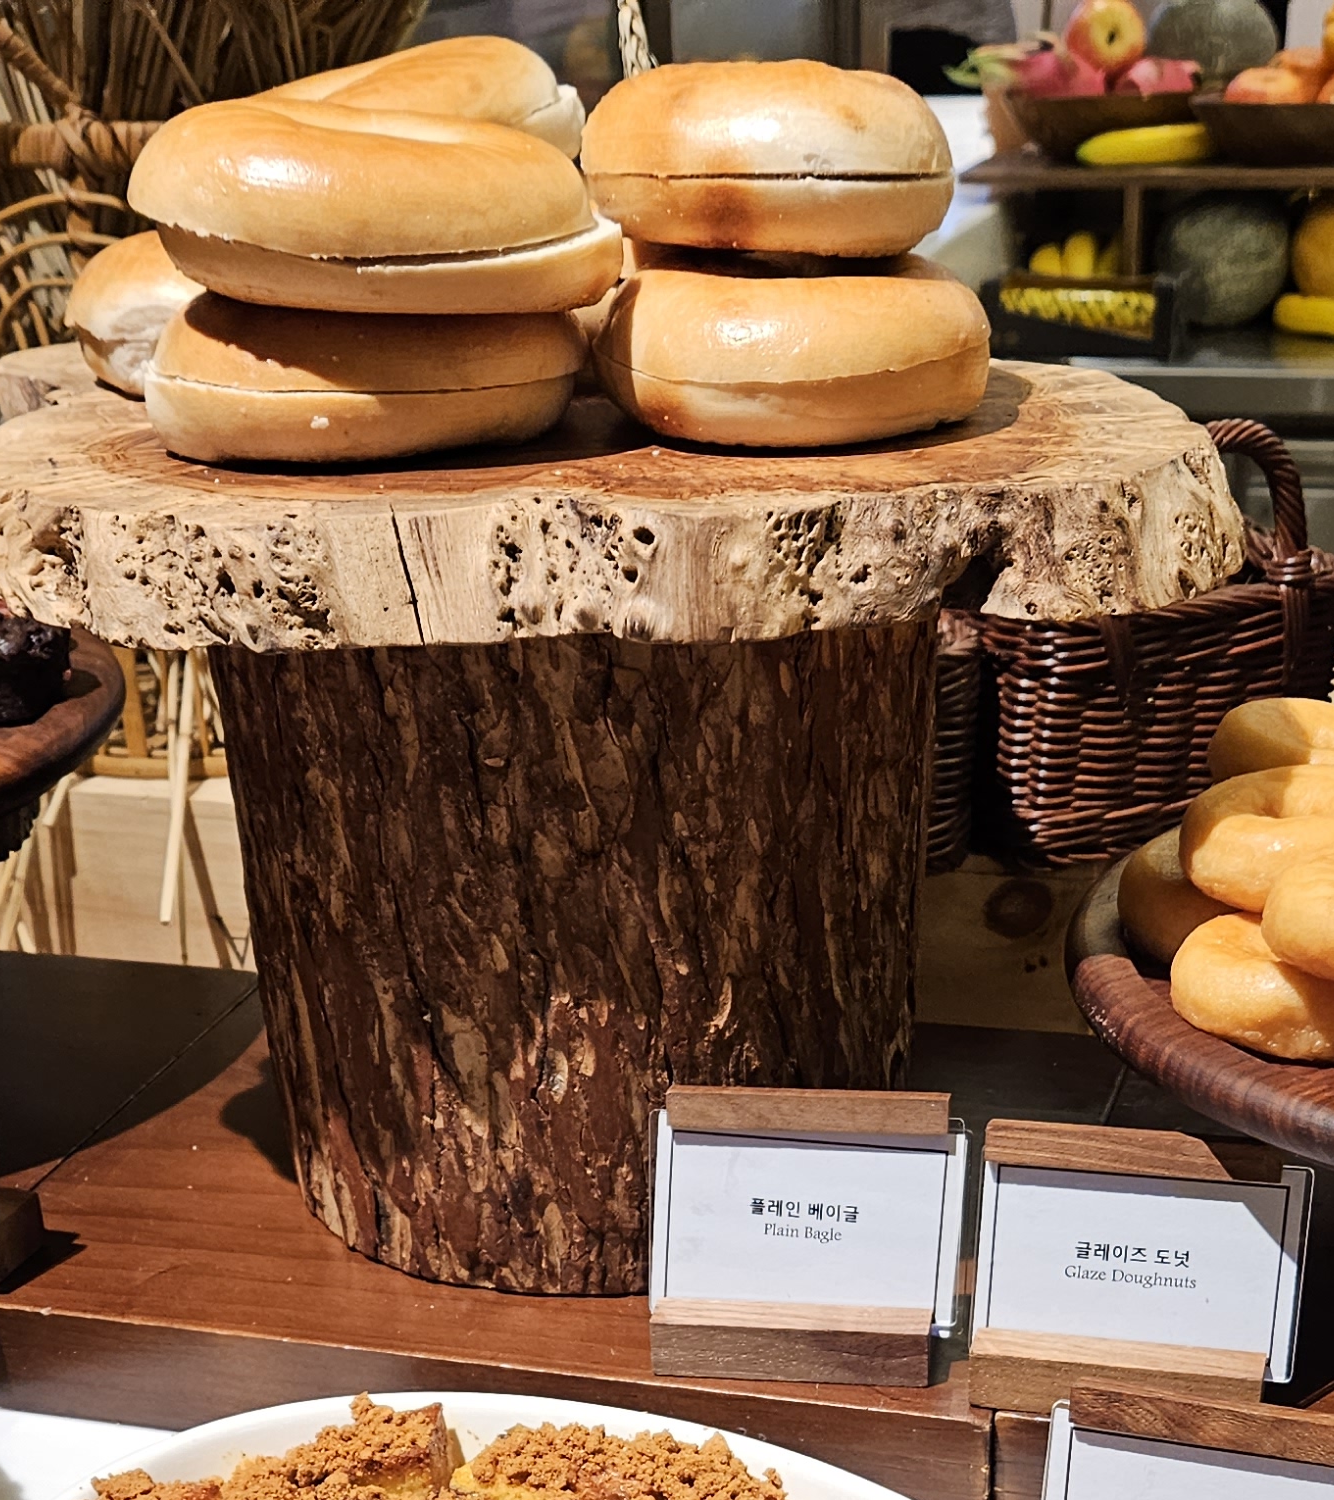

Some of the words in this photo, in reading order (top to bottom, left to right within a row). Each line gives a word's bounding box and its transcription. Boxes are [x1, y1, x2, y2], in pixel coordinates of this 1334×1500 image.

[749, 1197, 801, 1218] 플레인
[807, 1202, 859, 1223] 베이글
[763, 1222, 799, 1238] Plain
[804, 1226, 843, 1243] Bagle
[1075, 1241, 1148, 1263] 글레이즈
[1154, 1249, 1190, 1268] 도넛
[1064, 1265, 1107, 1281] Glaze
[1111, 1268, 1197, 1289] Doughnuts
